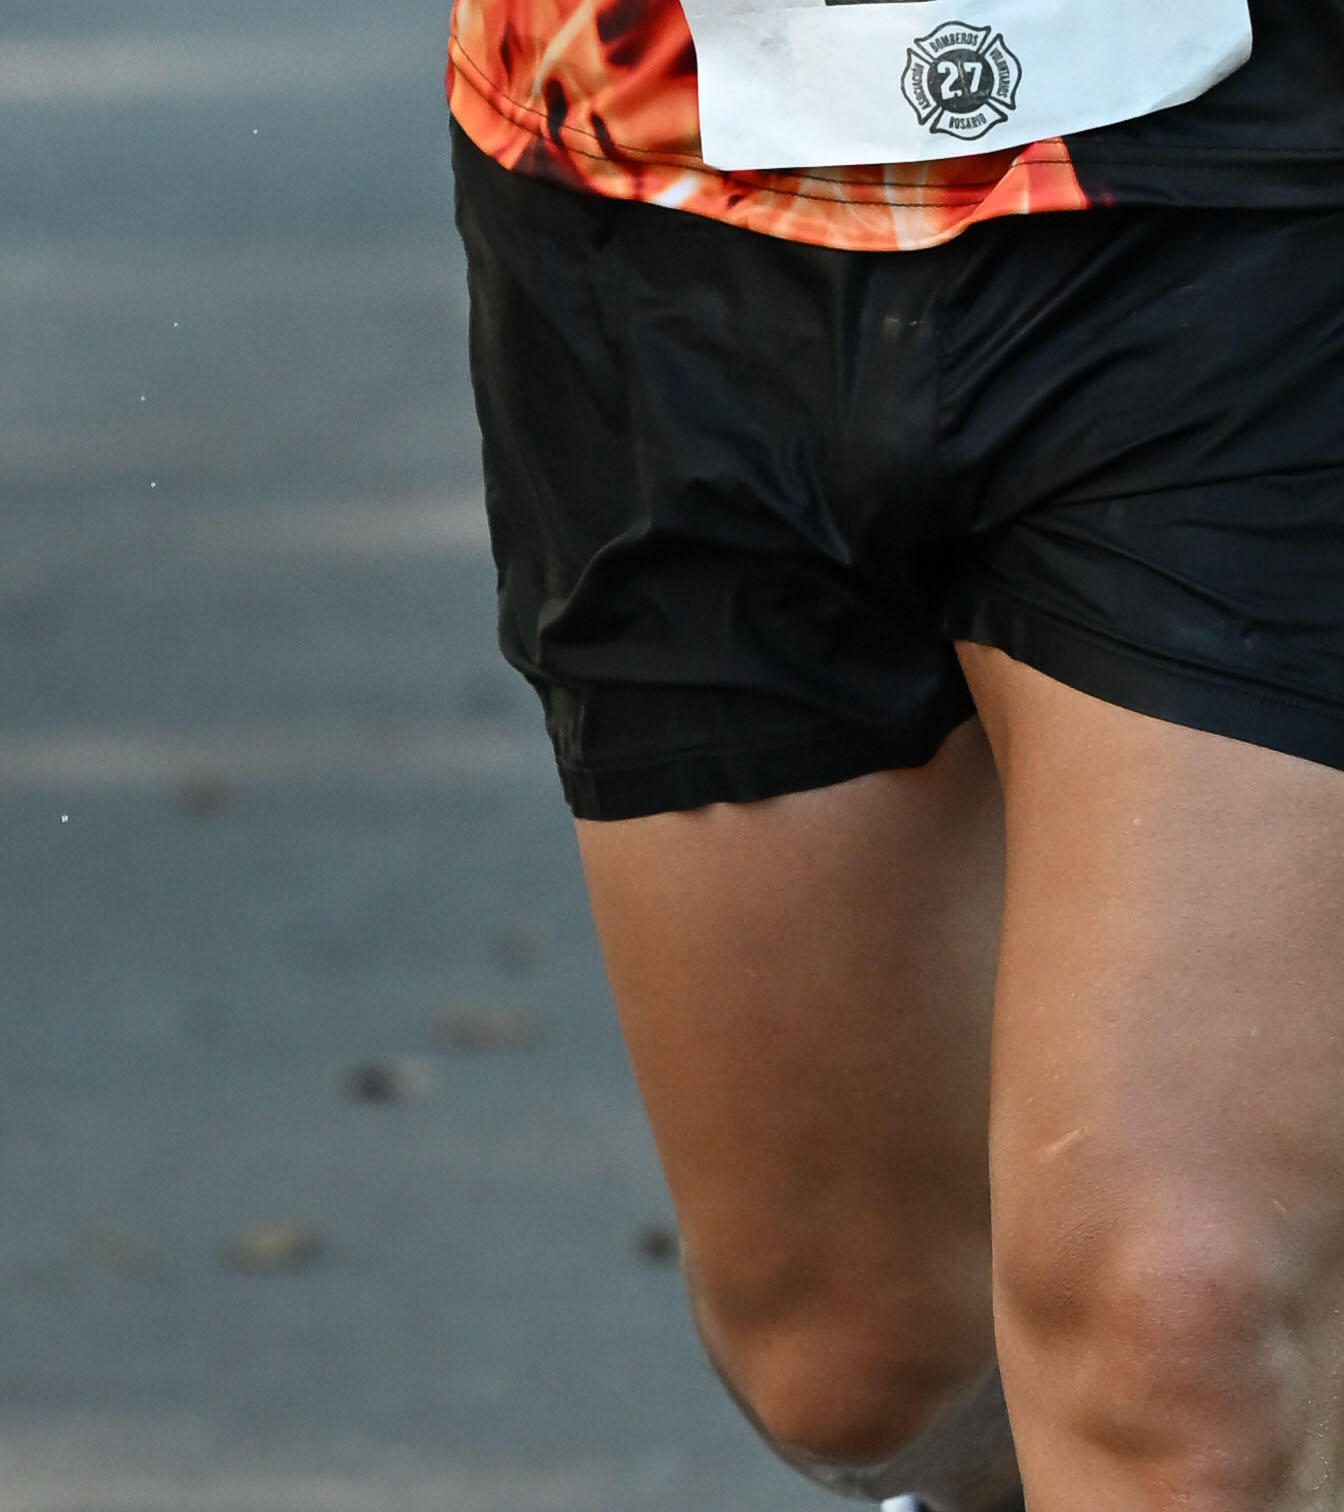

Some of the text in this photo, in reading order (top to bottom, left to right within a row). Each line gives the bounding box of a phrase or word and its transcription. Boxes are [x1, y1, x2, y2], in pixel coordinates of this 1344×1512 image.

[929, 32, 979, 53] BOMBEROS
[937, 60, 983, 100] 27
[948, 112, 987, 130] ROSARIO
